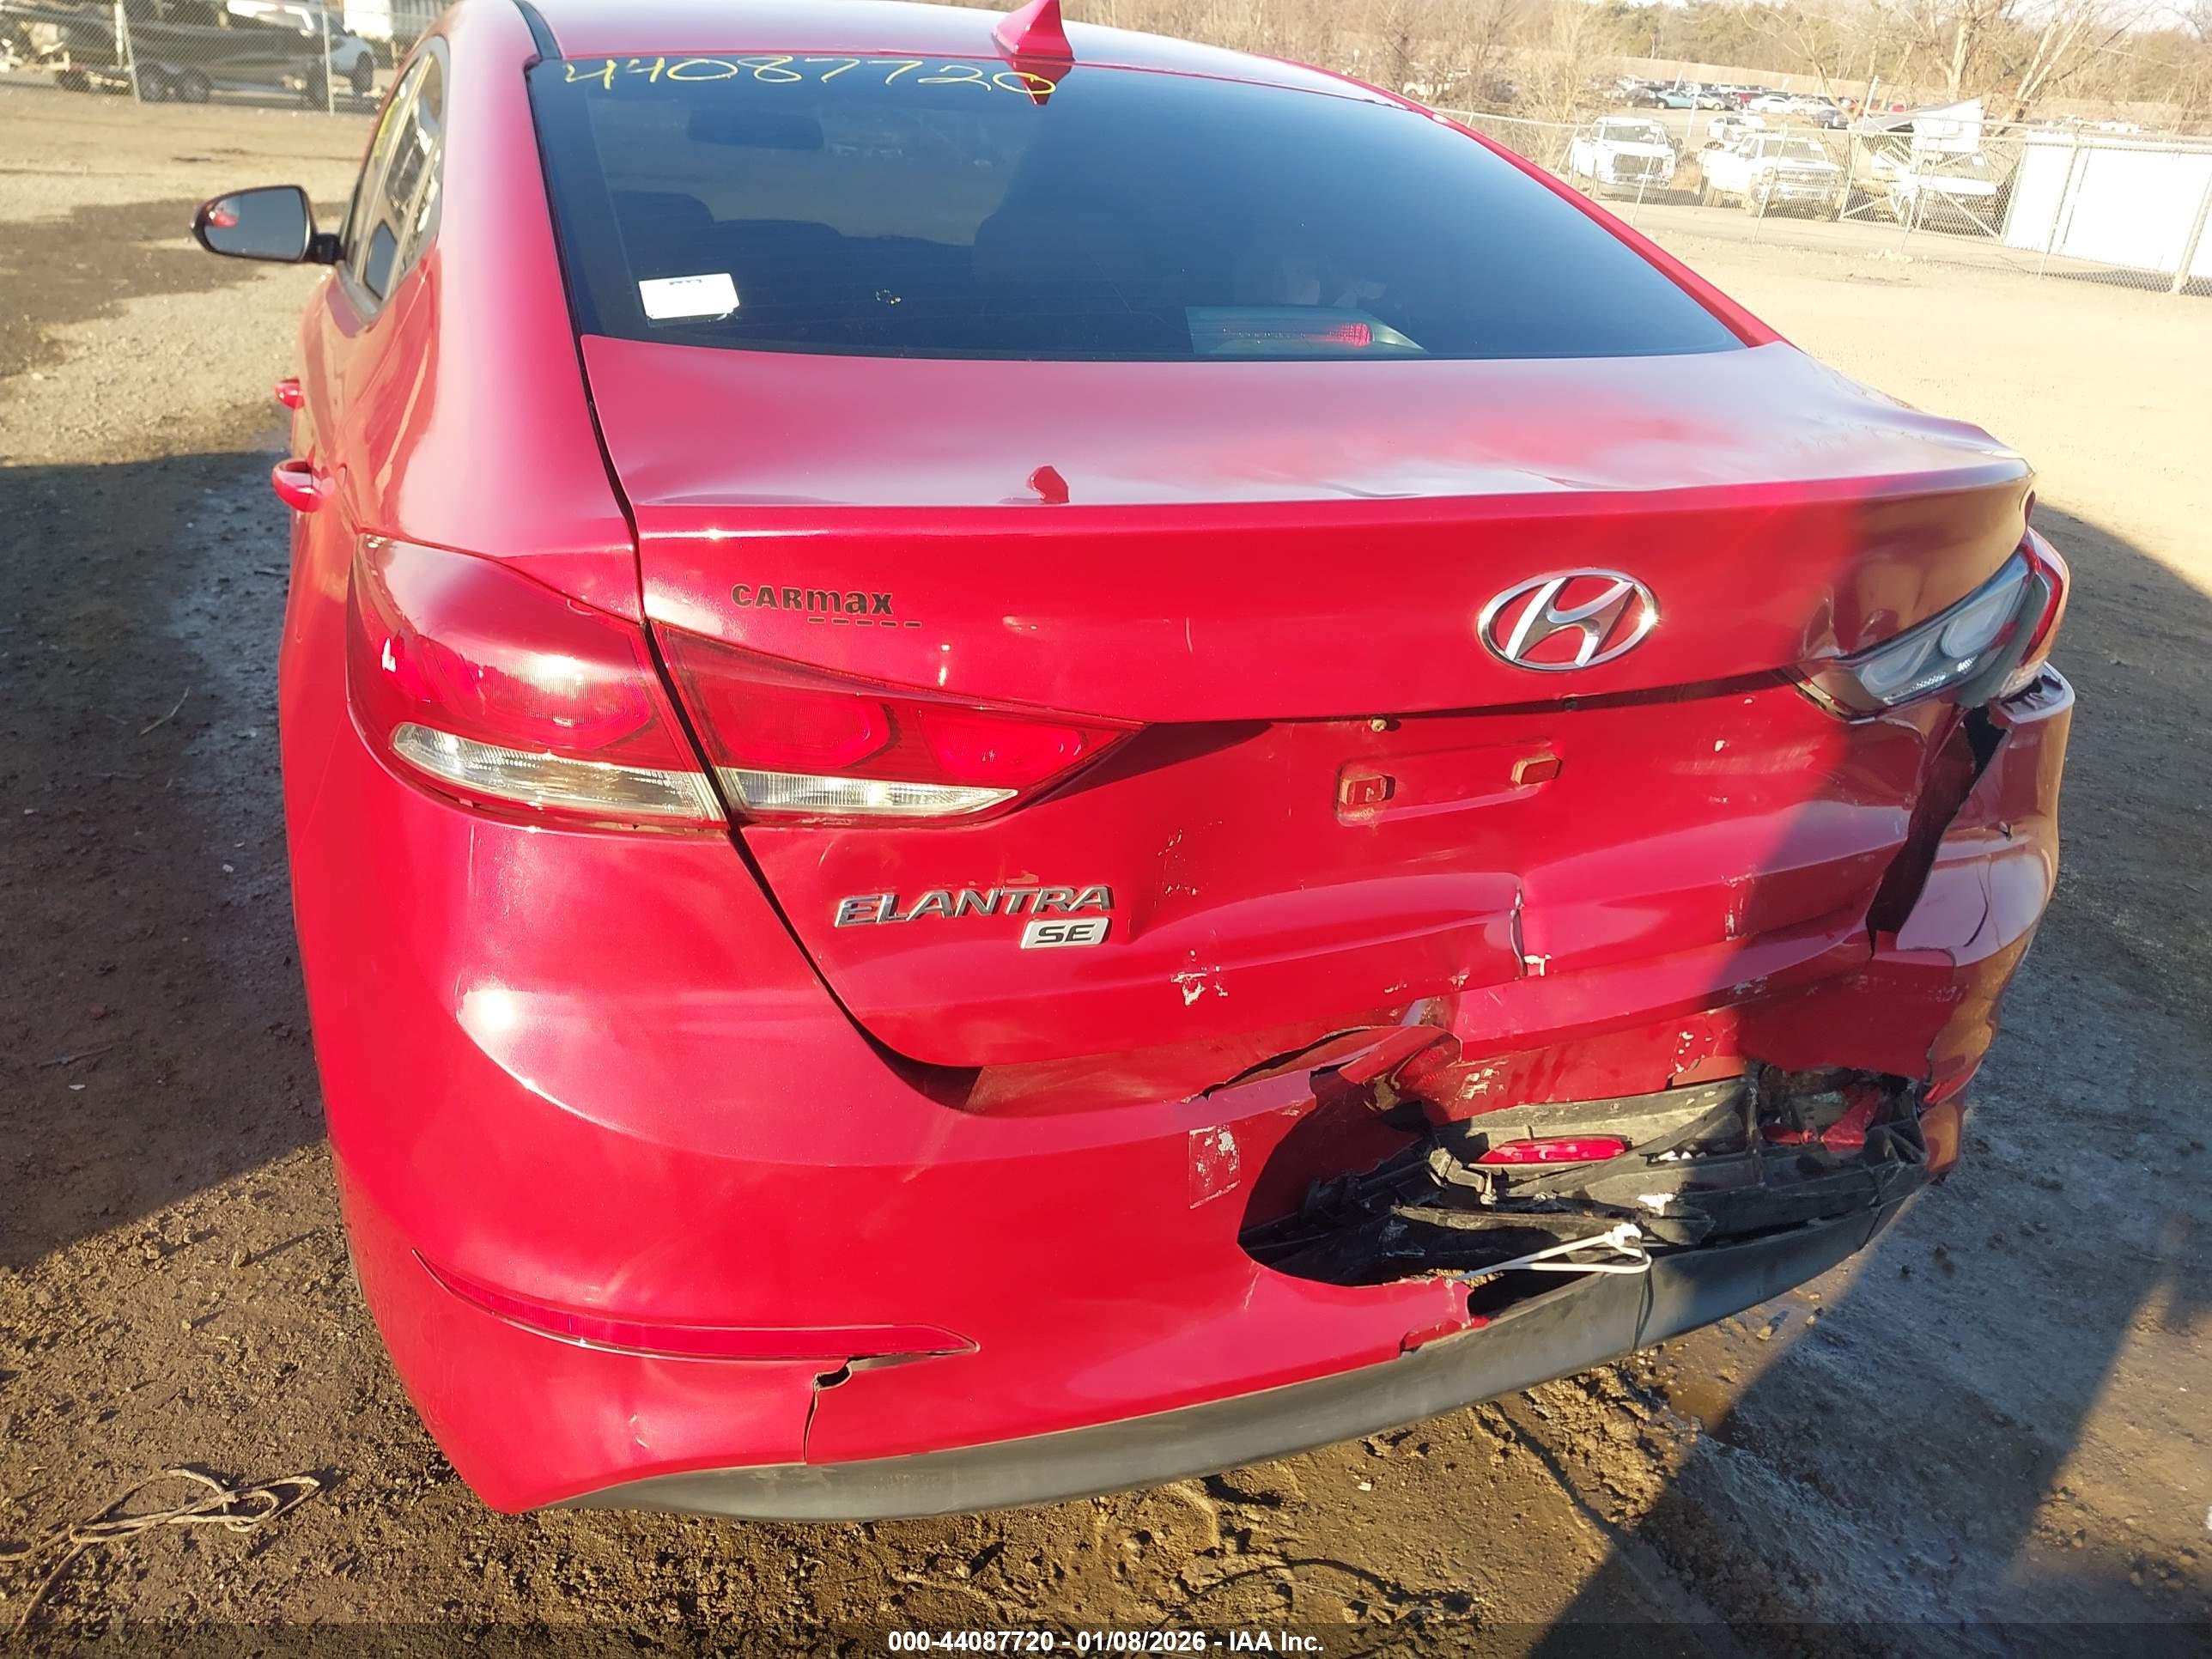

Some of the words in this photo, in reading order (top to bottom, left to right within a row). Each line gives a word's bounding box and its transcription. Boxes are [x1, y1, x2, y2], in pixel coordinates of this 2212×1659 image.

[564, 56, 1056, 94] 44087720
[834, 885, 1114, 928] ELANTRA
[1035, 923, 1096, 945] SE
